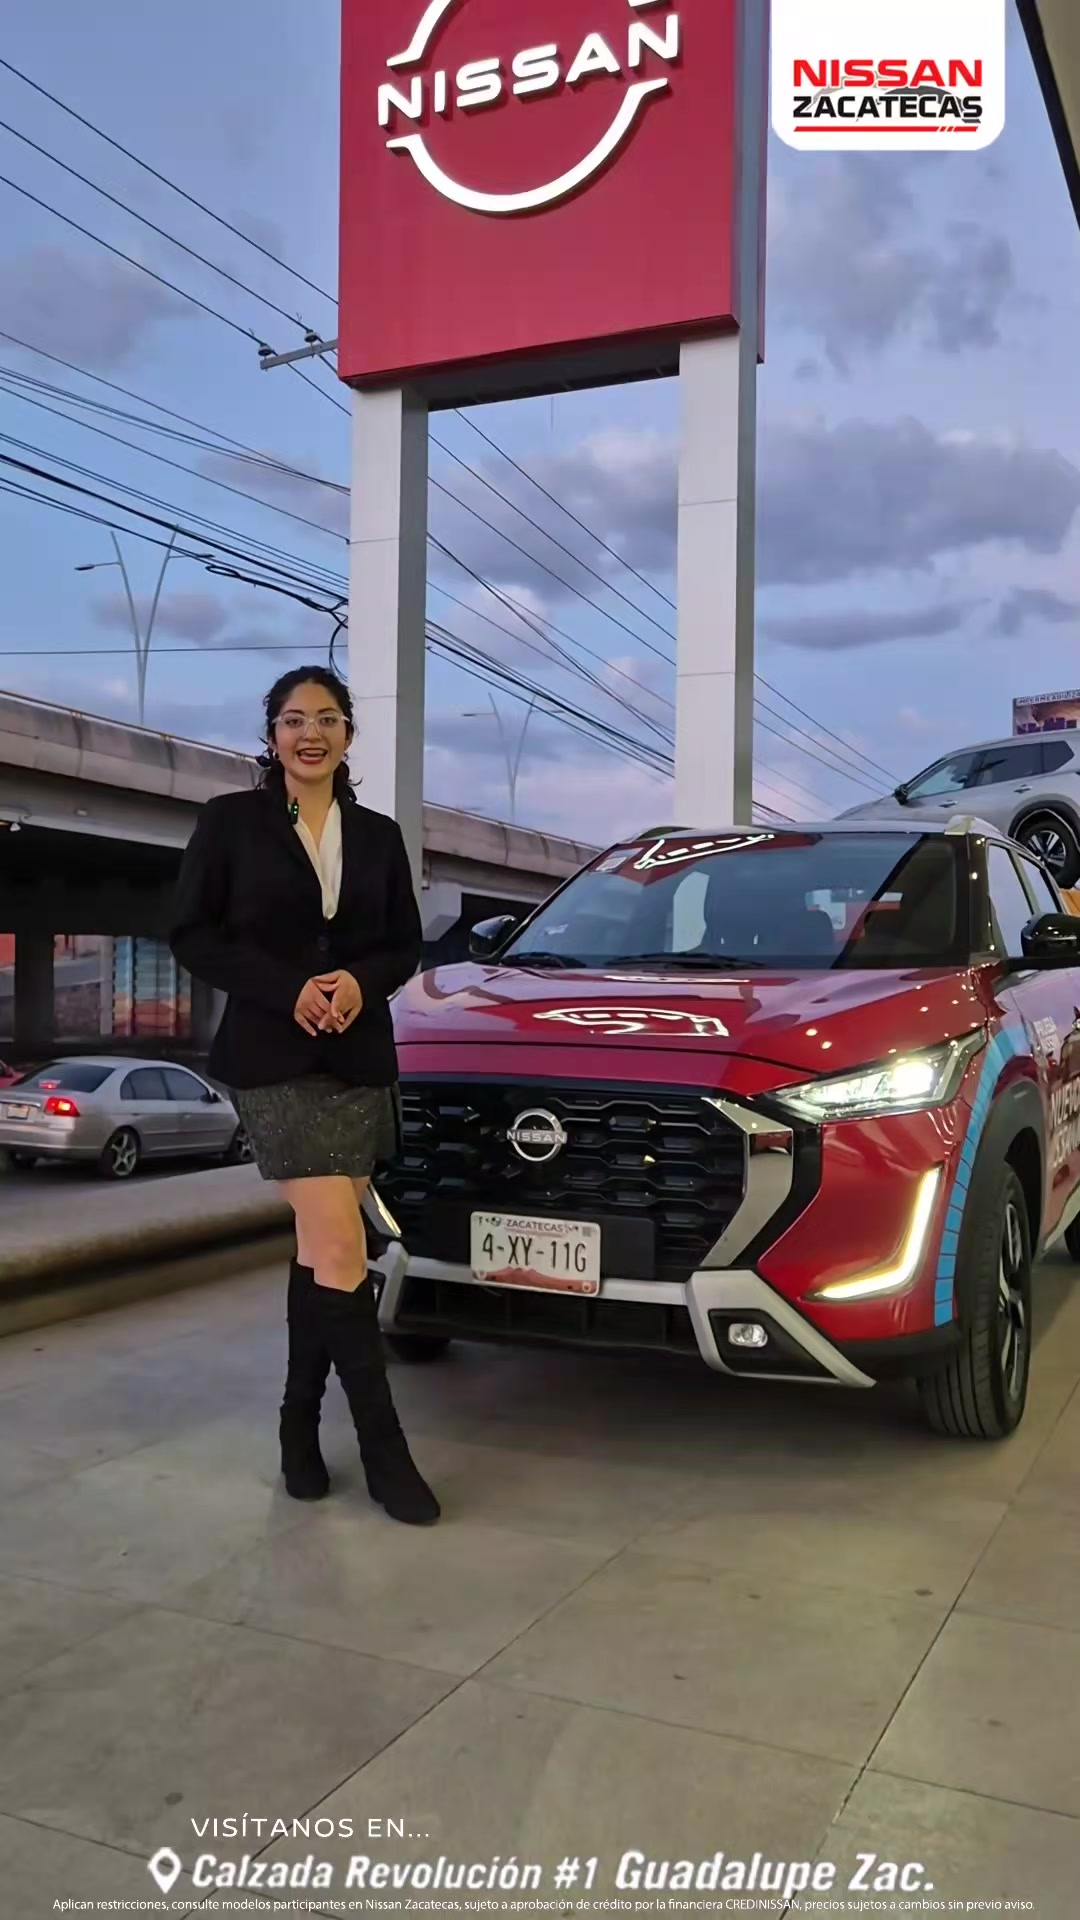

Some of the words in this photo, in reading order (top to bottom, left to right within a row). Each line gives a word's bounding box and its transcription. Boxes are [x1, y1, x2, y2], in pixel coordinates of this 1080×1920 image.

[378, 14, 681, 128] NISSAN
[506, 1130, 567, 1144] NISSAN
[506, 1219, 563, 1233] ZACATECAS
[482, 1232, 587, 1273] 4-XY-11G
